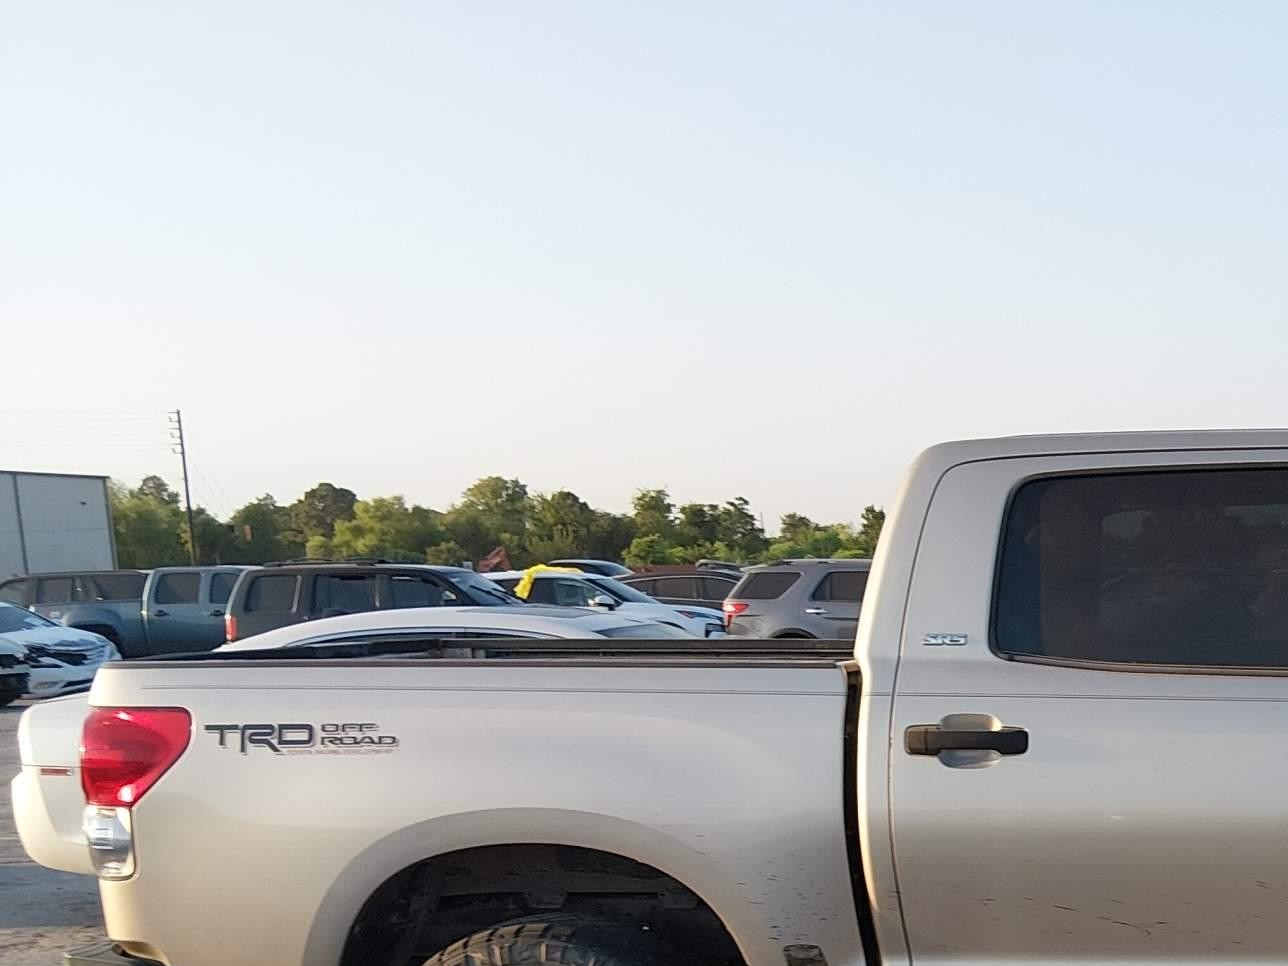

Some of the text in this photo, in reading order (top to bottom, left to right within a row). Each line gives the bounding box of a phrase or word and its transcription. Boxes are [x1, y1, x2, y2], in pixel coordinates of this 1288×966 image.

[320, 723, 379, 733] OFF
[204, 723, 316, 754] TRD
[320, 735, 399, 747] ROAD
